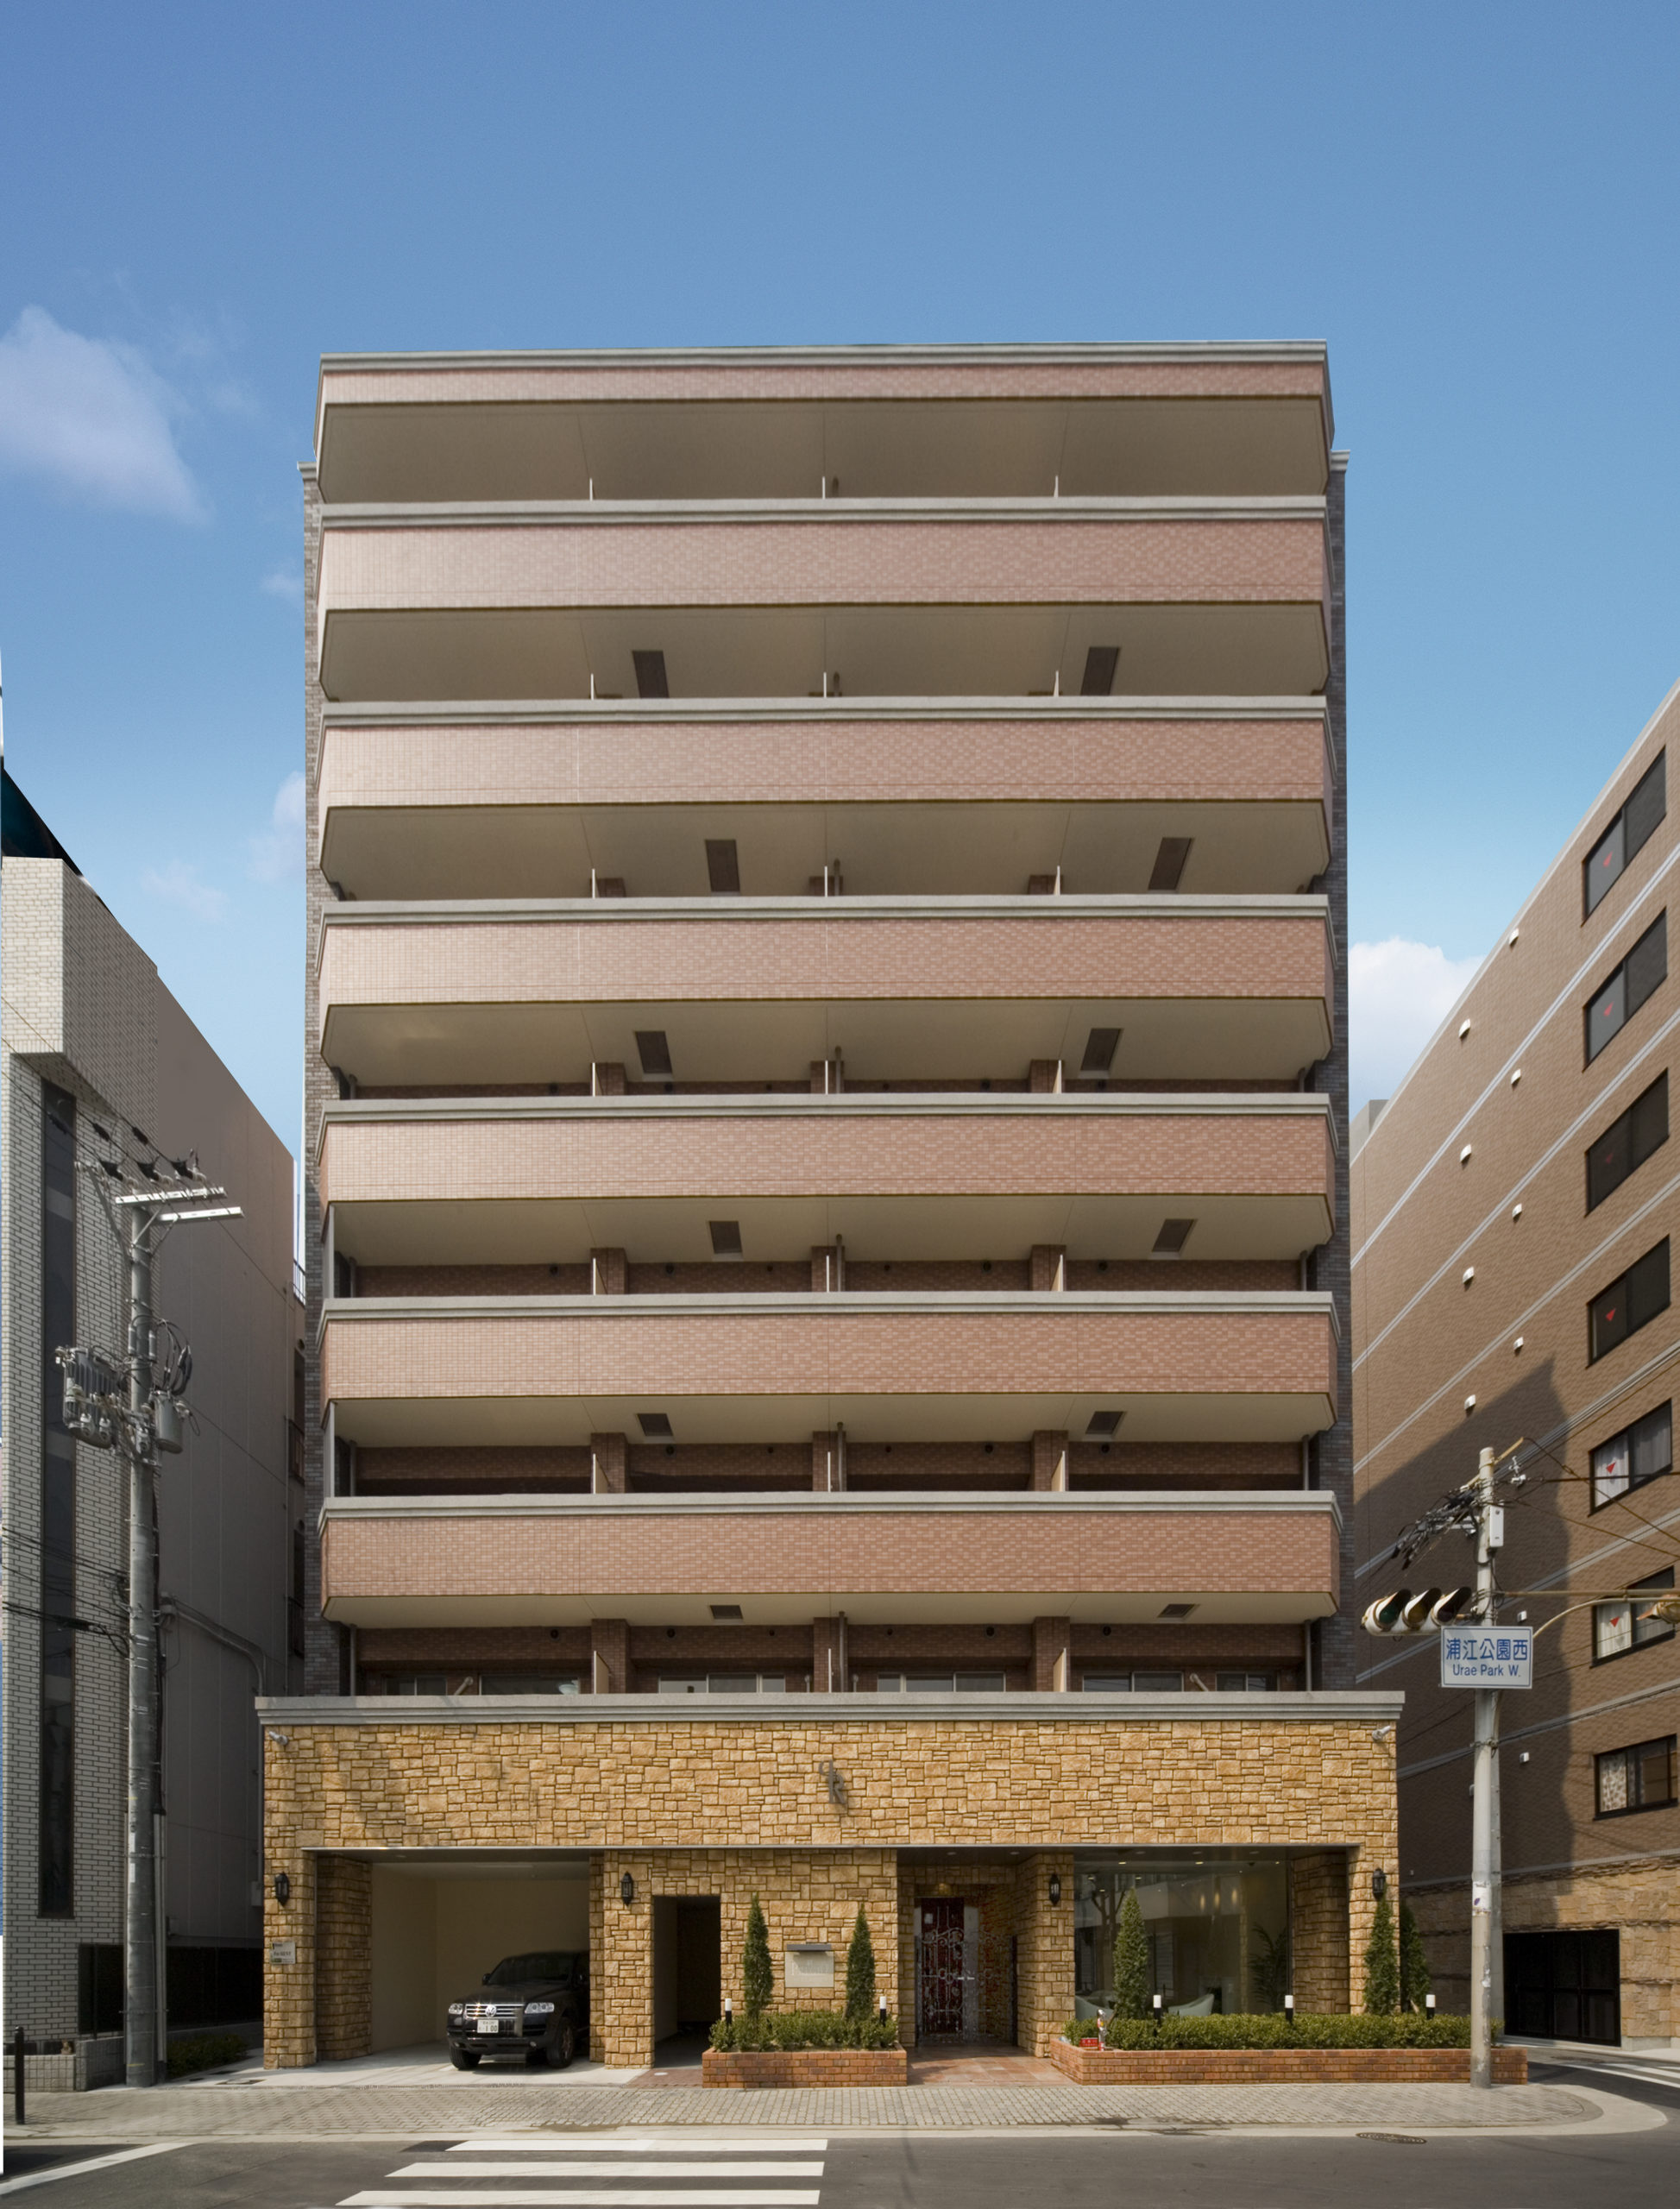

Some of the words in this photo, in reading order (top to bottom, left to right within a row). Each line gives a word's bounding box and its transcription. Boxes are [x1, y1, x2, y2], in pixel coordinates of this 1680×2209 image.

[1446, 1638, 1528, 1660] 浦江公園西
[1453, 1664, 1477, 1677] Urae
[1481, 1664, 1504, 1677] Park
[1508, 1664, 1521, 1677] W.
